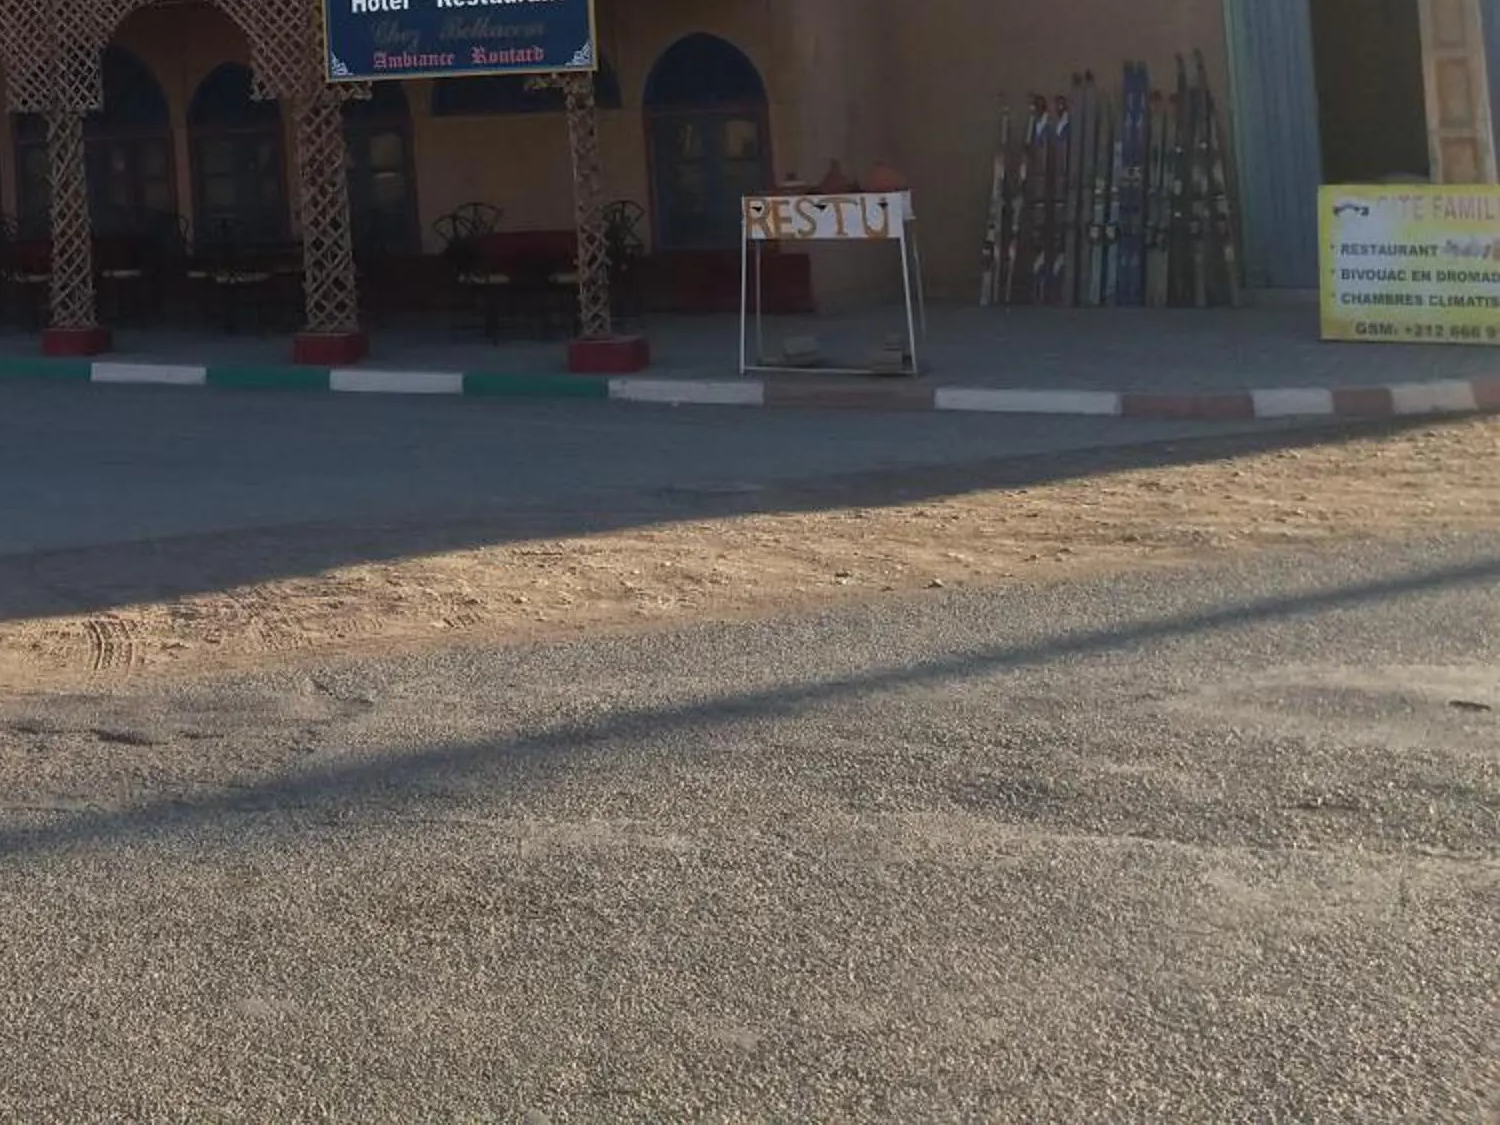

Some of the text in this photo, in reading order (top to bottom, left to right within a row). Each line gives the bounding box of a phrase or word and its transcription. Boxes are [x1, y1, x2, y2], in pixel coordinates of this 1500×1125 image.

[373, 50, 456, 69] Ambiance
[1432, 194, 1500, 221] FAMIL
[1340, 242, 1440, 257] RESTAURANT
[1340, 267, 1407, 282] BIVOUAC
[1340, 292, 1423, 306] CHAMBRES
